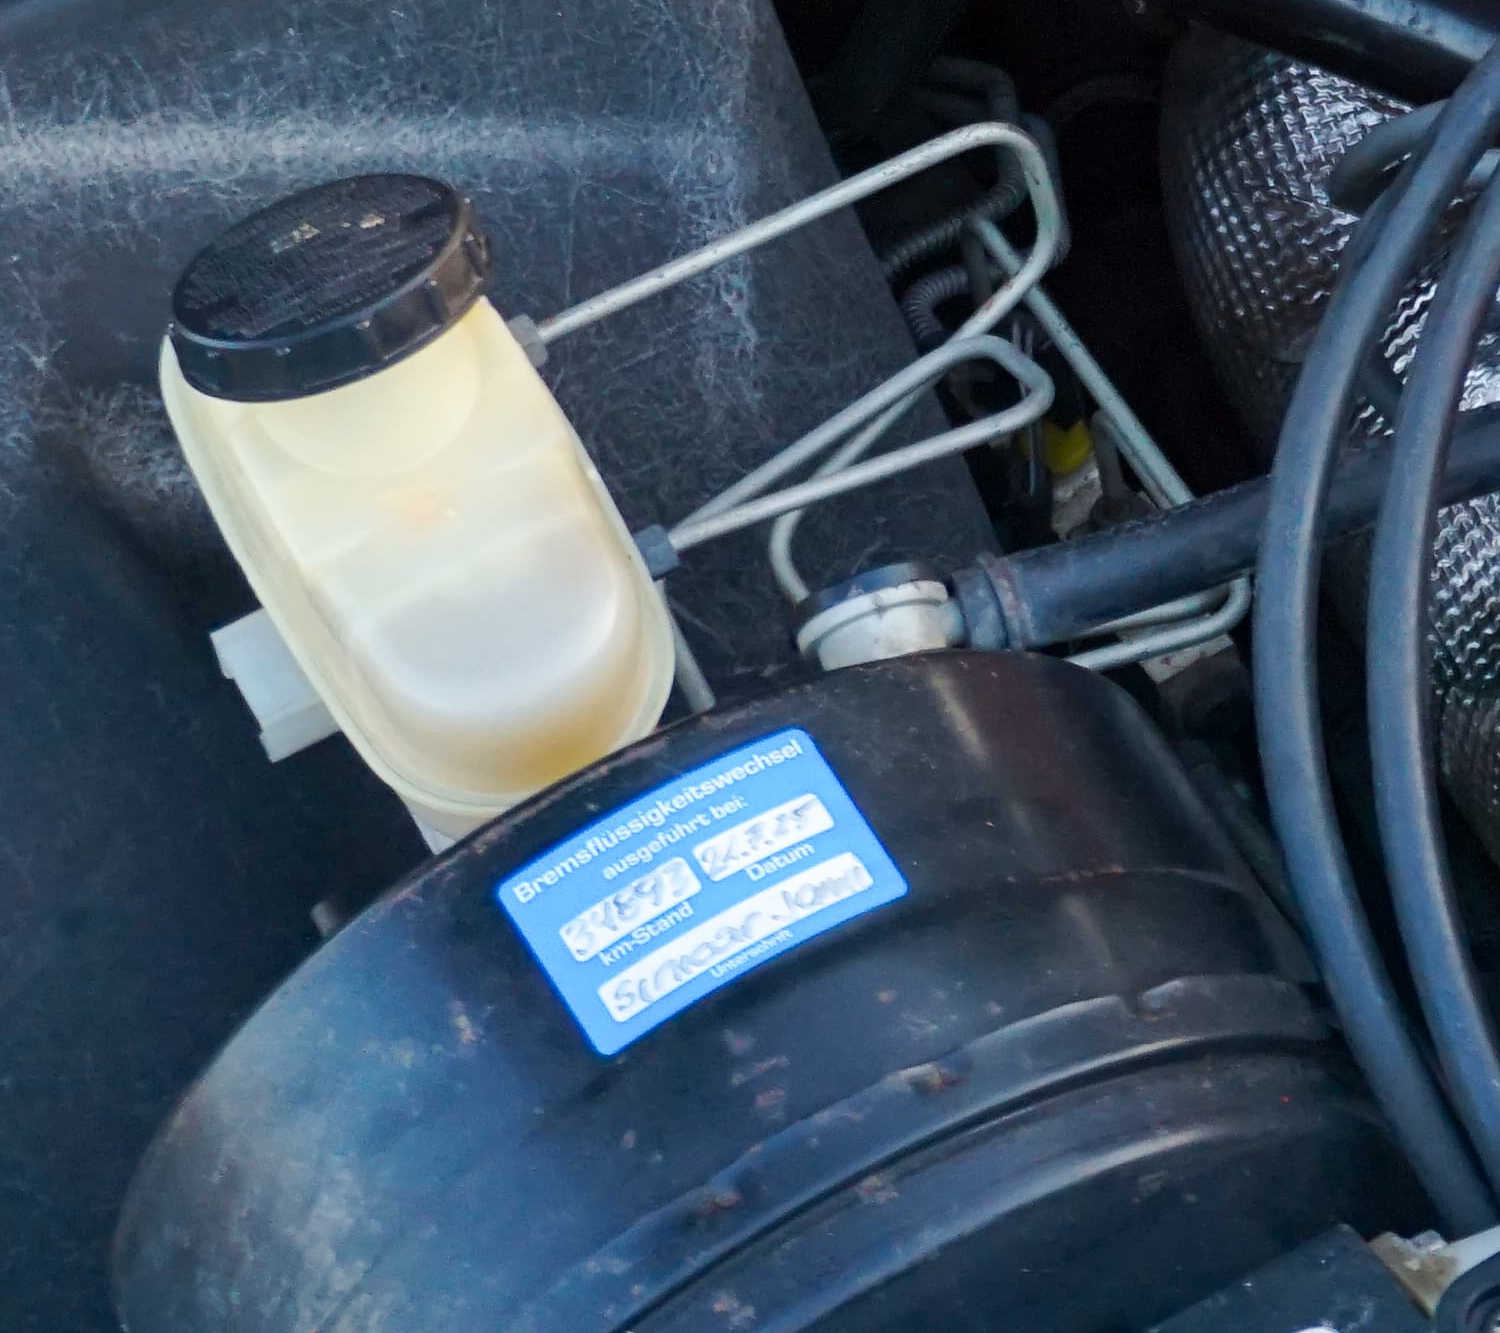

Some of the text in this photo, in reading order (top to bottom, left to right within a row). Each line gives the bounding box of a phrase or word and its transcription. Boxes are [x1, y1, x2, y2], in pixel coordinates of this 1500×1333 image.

[511, 738, 804, 904] Bremsflüssigkeitswechsel
[602, 794, 748, 881] ausgeführt bei:
[743, 842, 816, 881] Datum
[598, 900, 695, 966] km-Stand
[709, 929, 795, 979] Unterschrift
